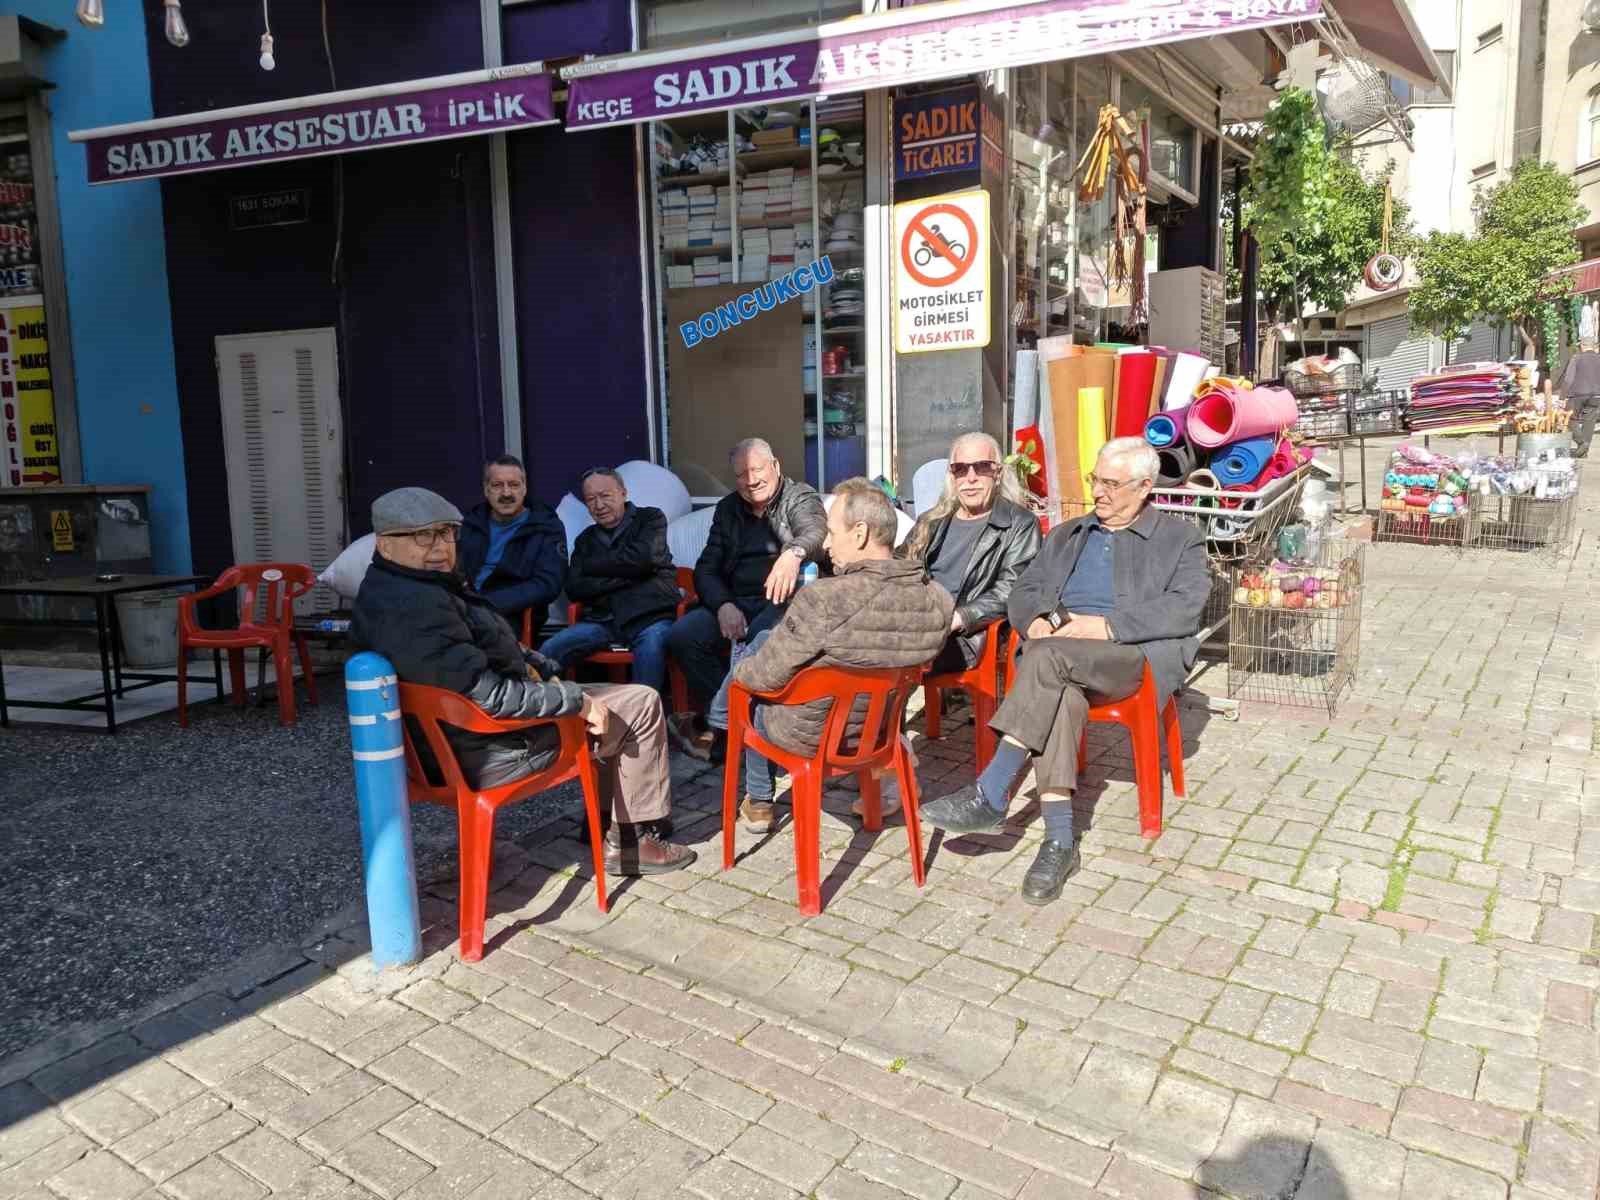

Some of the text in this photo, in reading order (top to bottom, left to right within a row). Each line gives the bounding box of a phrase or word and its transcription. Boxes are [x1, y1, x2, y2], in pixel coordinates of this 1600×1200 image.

[577, 97, 633, 121] KEÇE
[653, 54, 798, 108] SADIK
[106, 91, 527, 176] SADIK AKSESUAR İPLİK
[901, 99, 977, 142] SADIK
[679, 254, 834, 348] BONCUKCU
[899, 289, 984, 311] MOTOSİKLET
[913, 306, 969, 327] GİRMESİ
[908, 328, 975, 346] YASAKTIR
